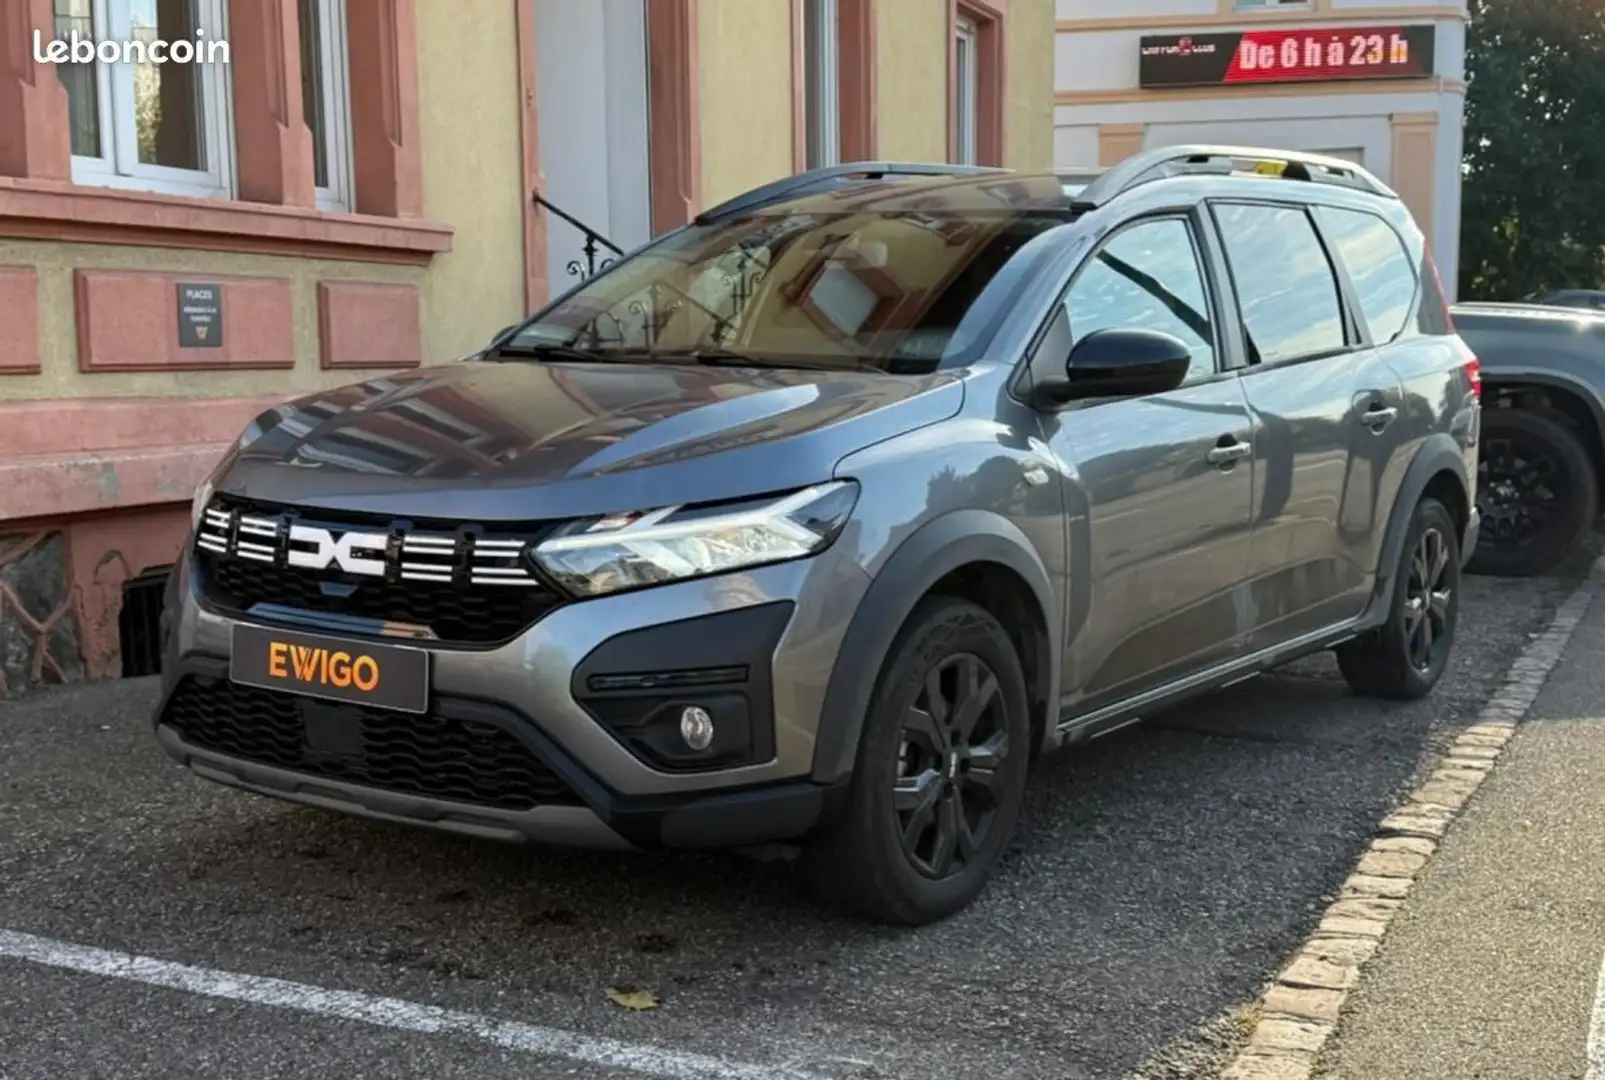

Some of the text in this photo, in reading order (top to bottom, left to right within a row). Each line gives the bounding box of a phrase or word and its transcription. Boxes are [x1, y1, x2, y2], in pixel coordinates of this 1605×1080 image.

[1240, 40, 1275, 69] De
[1281, 38, 1298, 68] 6
[1304, 37, 1321, 67] h
[1350, 35, 1384, 65] 23
[1390, 34, 1408, 64] h
[269, 641, 379, 691] EWIGO
